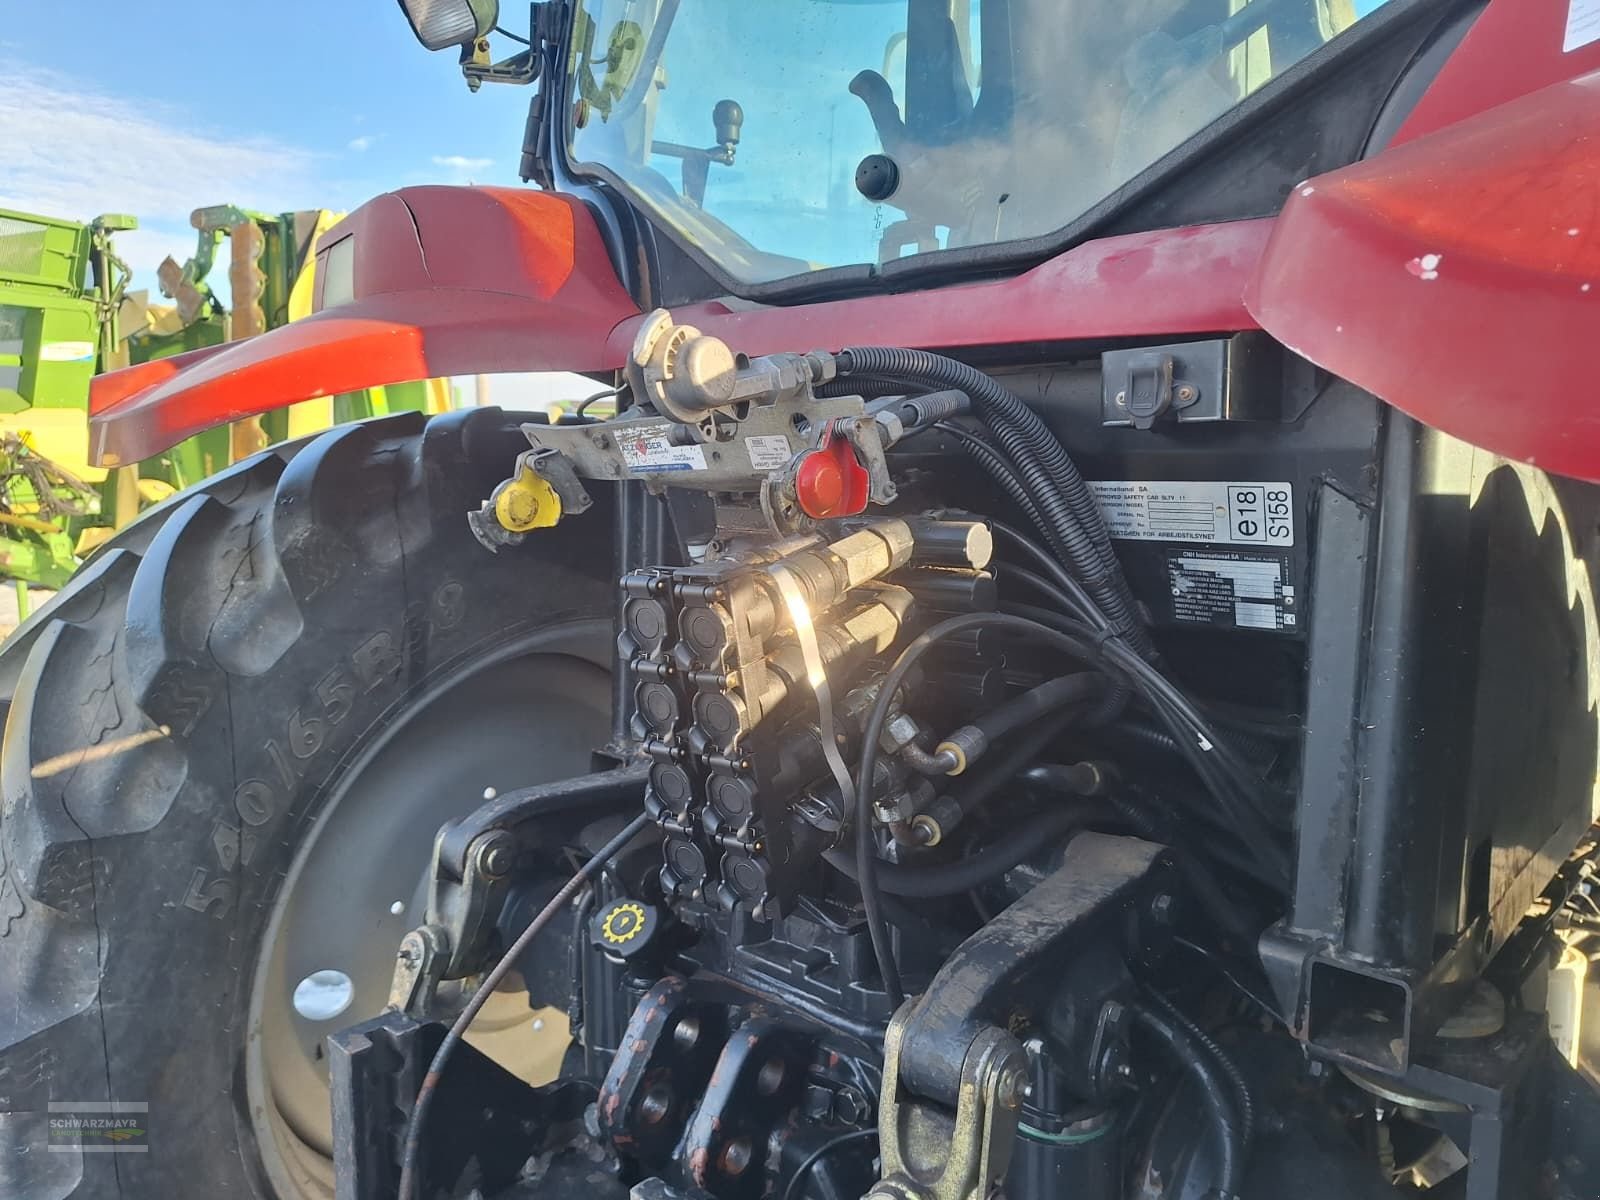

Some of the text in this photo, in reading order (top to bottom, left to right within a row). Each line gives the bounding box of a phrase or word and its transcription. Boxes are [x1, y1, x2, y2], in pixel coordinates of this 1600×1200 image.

[1158, 531, 1215, 540] ARBEJDSTILSYNET
[1236, 491, 1258, 536] e18
[1267, 490, 1290, 538] S158
